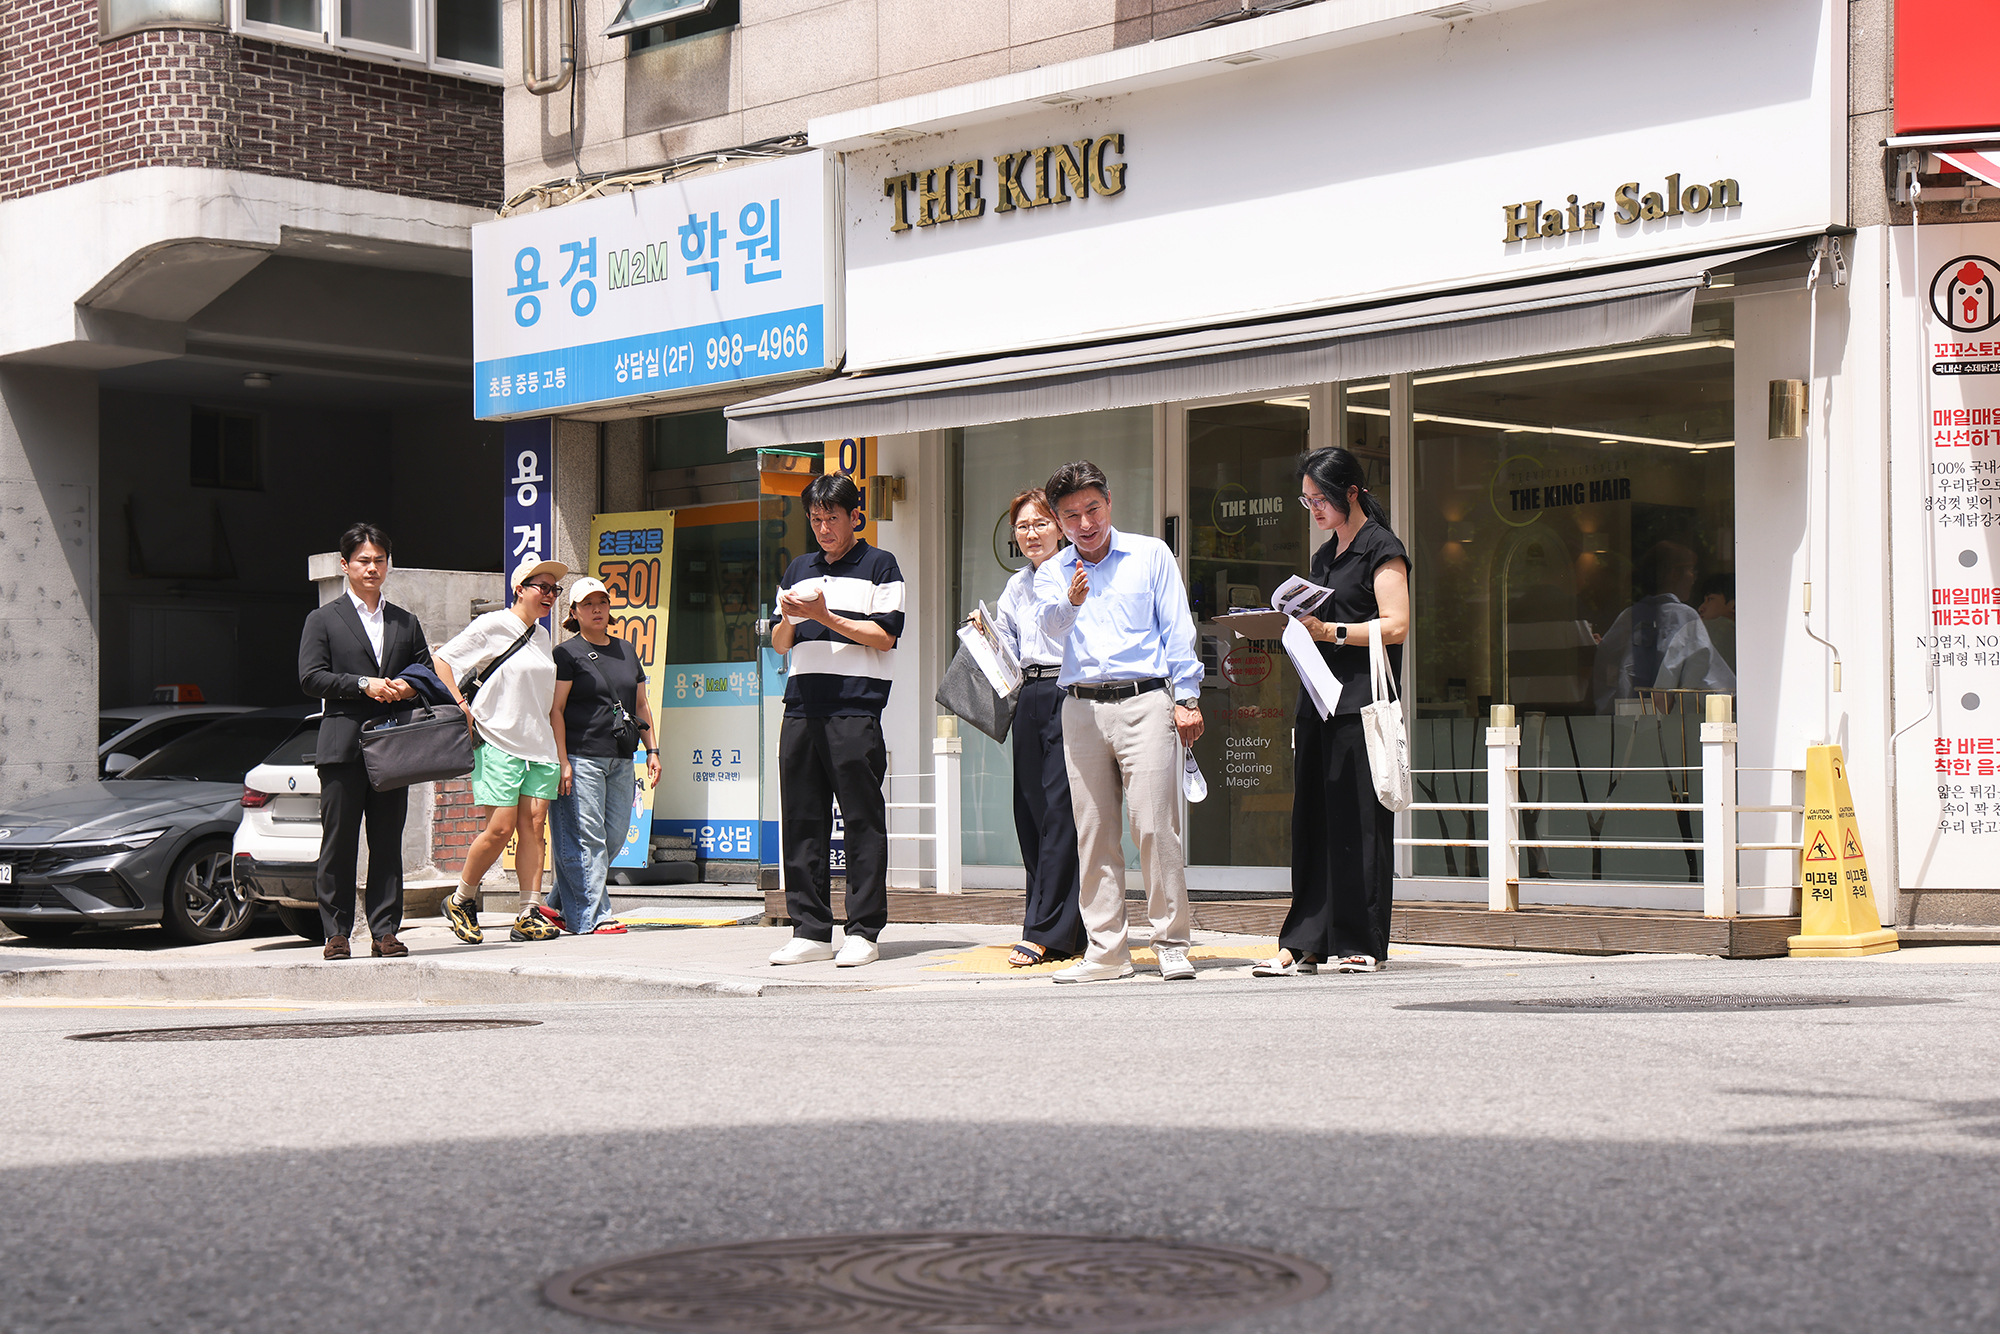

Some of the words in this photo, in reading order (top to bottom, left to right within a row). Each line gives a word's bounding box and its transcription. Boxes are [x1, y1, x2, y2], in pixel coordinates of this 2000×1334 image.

[884, 159, 986, 232] THE
[993, 133, 1127, 213] KING
[1502, 194, 1605, 243] Hair
[1614, 173, 1742, 225] Salon
[507, 237, 597, 327] 용경
[608, 241, 668, 290] M2M
[678, 199, 783, 291] 학원
[707, 323, 808, 370] 998-4966
[1935, 363, 1962, 374] 국내산
[1964, 363, 2000, 373] 수제닭강
[489, 376, 512, 397] 초등
[516, 372, 539, 395] 중등
[543, 367, 566, 389] 고등
[1931, 461, 1965, 475] 100%
[1970, 459, 2000, 475] 국내
[1510, 487, 1540, 511] THE
[1544, 482, 1585, 508] KING
[1589, 478, 1631, 503] HAIR
[1220, 500, 1246, 518] THE
[1249, 496, 1283, 515] KING
[1966, 495, 1992, 510] 빚어
[1256, 516, 1279, 527] Hair
[598, 528, 663, 556] 초등전문
[1247, 638, 1265, 653] THE
[1267, 639, 1288, 655] KIN
[674, 673, 704, 699] 용경
[706, 678, 728, 692] M2M
[729, 671, 759, 697] 학원
[1225, 736, 1271, 748] Cut&dry
[1934, 737, 1952, 755] 참
[1226, 750, 1256, 760] Perm
[1225, 763, 1272, 775] Coloring
[1935, 758, 1971, 776] 착한
[1977, 758, 2000, 776] 음
[1226, 776, 1260, 788] Magic
[1937, 784, 1965, 799] 얇은
[1970, 784, 2000, 799] 튀김
[1942, 802, 1969, 816] 속이
[1974, 802, 1989, 816] 꽉
[628, 827, 638, 838] 3F
[1937, 819, 1965, 834] 우리
[1970, 819, 2000, 834] 닭고
[1805, 872, 1837, 886] 미끄럼
[1811, 888, 1833, 902] 주의
[1852, 884, 1867, 899] 주의
